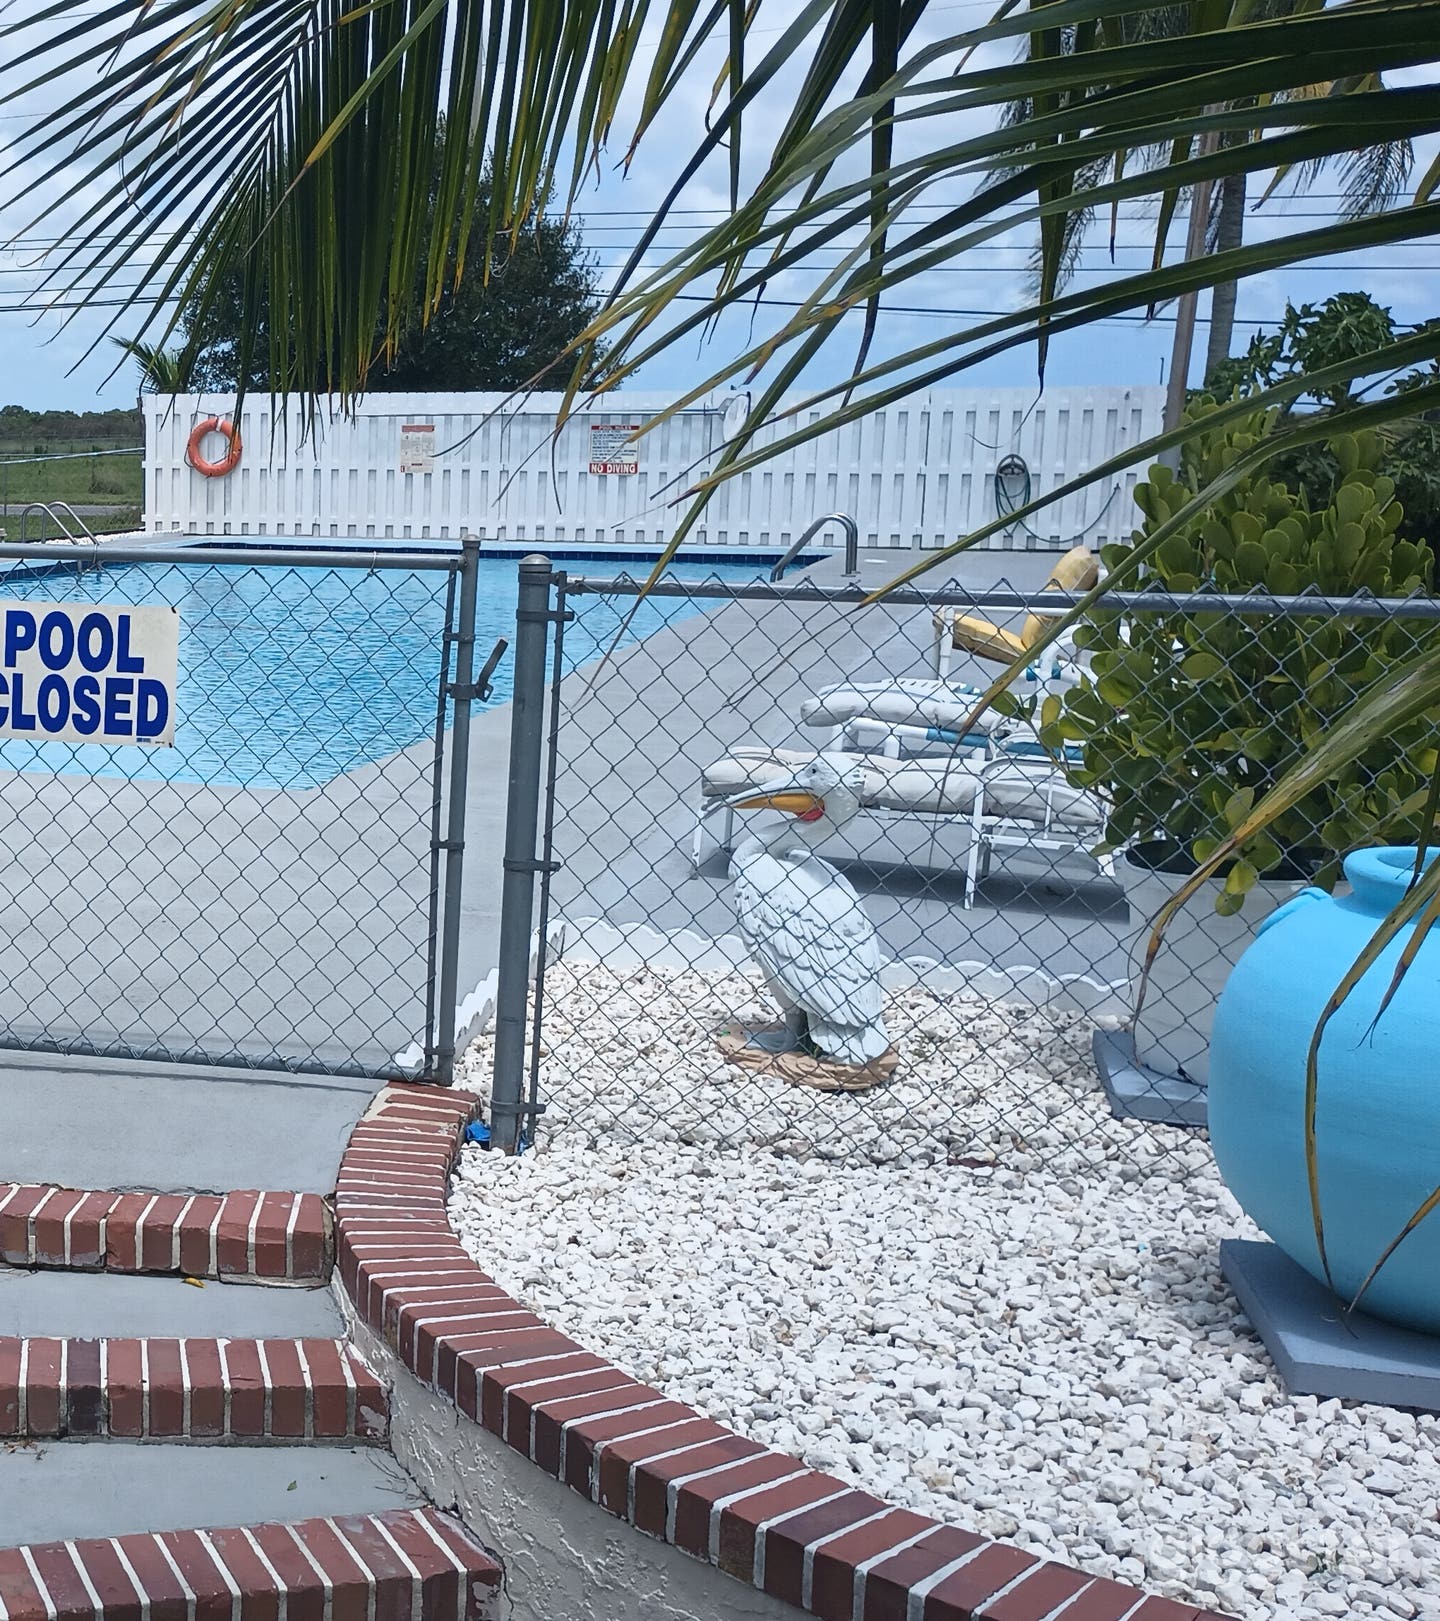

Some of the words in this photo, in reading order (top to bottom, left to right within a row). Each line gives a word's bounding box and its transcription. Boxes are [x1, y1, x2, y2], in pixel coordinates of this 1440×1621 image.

[591, 464, 604, 473] NO
[607, 464, 636, 473] DIVING
[4, 609, 145, 674] POOL
